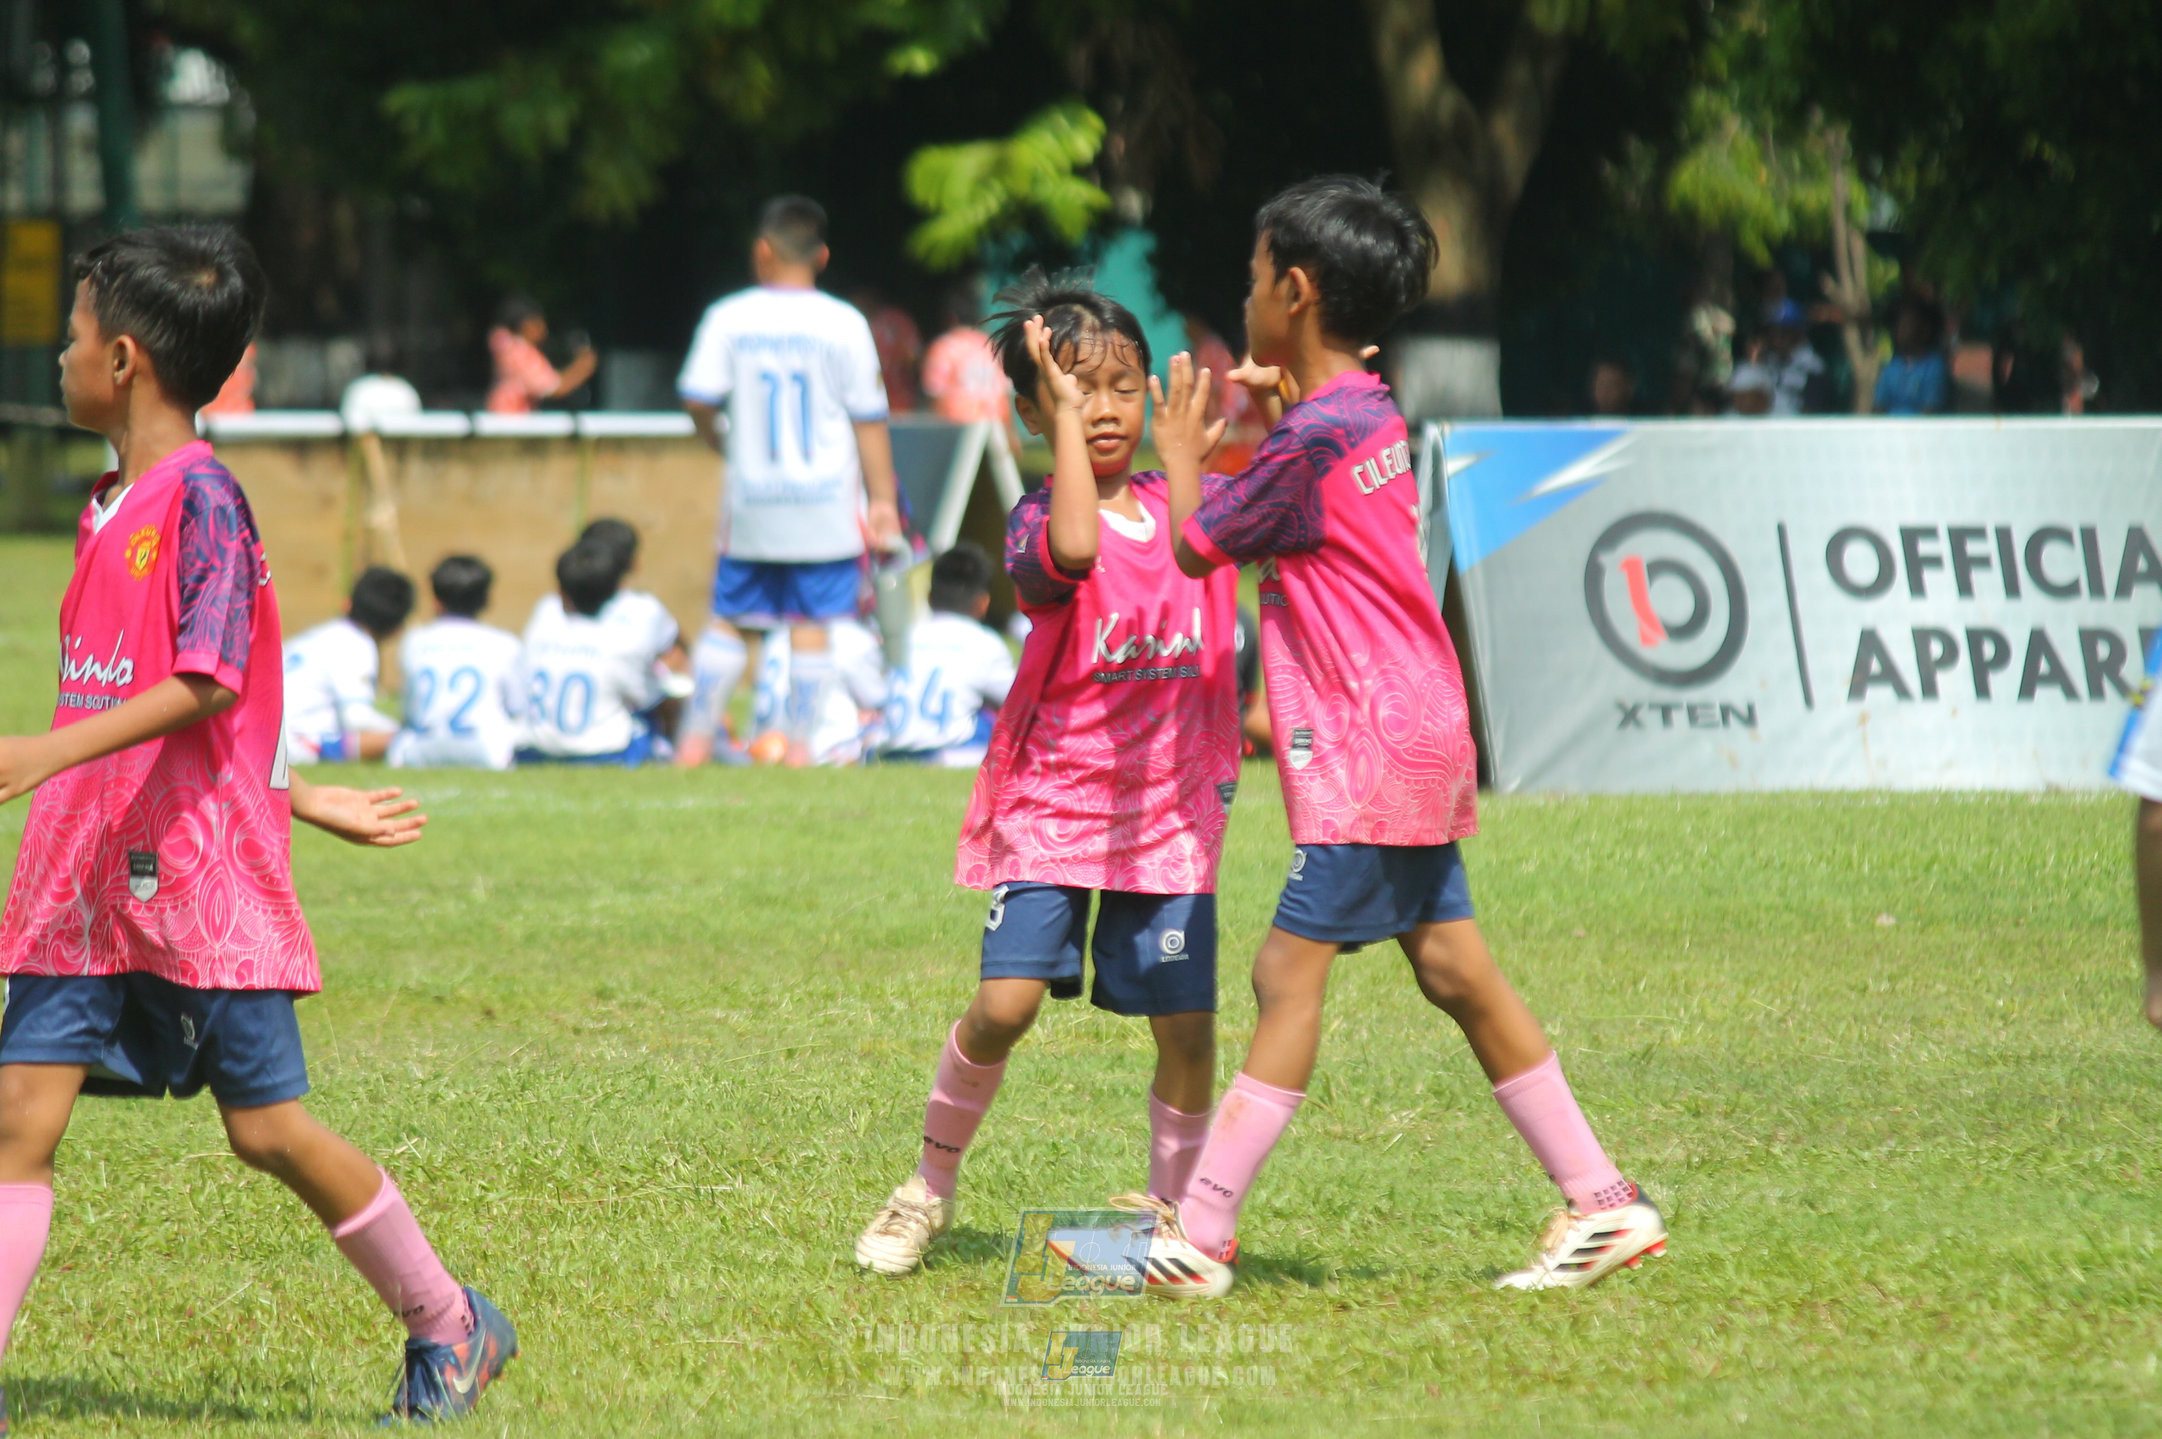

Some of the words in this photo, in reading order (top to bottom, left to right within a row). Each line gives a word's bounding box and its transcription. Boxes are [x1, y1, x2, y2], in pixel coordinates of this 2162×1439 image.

[1825, 525, 2162, 601] OFFICIA
[410, 666, 485, 736] 22
[1615, 699, 1759, 731] XTEN
